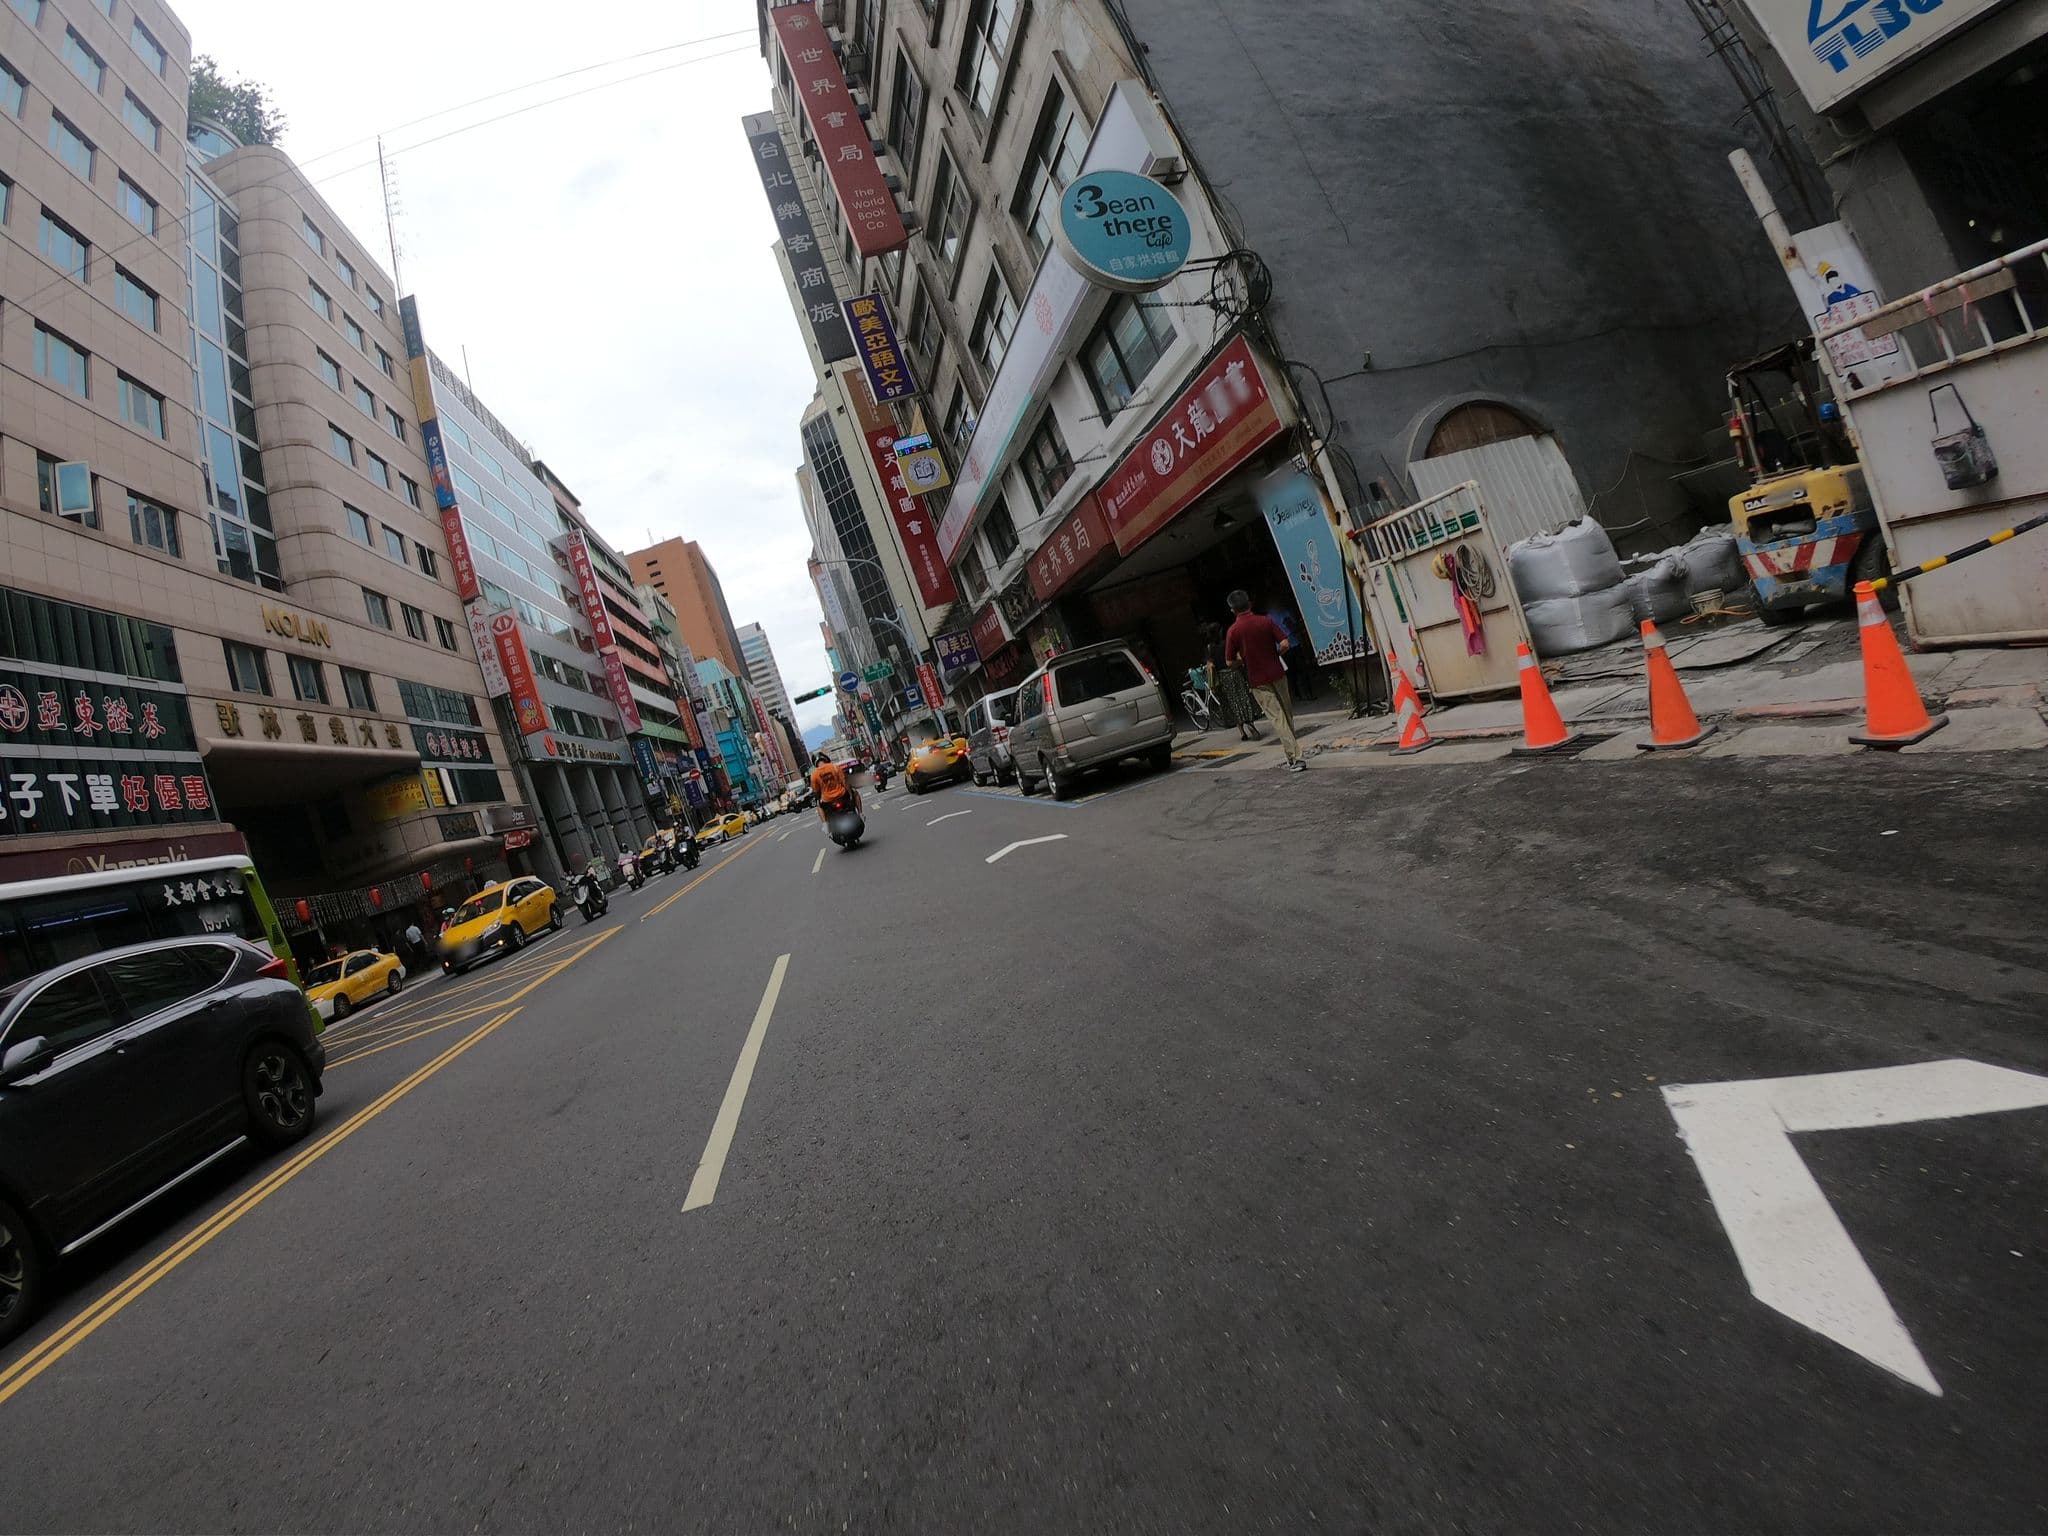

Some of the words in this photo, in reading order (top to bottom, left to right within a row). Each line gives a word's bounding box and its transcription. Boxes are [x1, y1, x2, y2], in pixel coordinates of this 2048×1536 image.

[797, 47, 864, 162] 世界書局
[852, 196, 885, 210] World
[854, 188, 875, 198] The
[858, 208, 887, 221] Book
[758, 141, 840, 323] 台北樂客商旅
[866, 220, 888, 231] Co.
[1103, 215, 1172, 237] there
[850, 299, 903, 387] 歐美亞語文
[886, 386, 903, 397] 9F
[1037, 517, 1090, 587] 世界書局
[261, 604, 331, 649] KOLIN
[937, 632, 974, 658] 歐美亞
[37, 689, 166, 740] 亞東證券
[216, 701, 402, 748] 歌林商業大樓
[0, 773, 210, 821] 子下單好優惠
